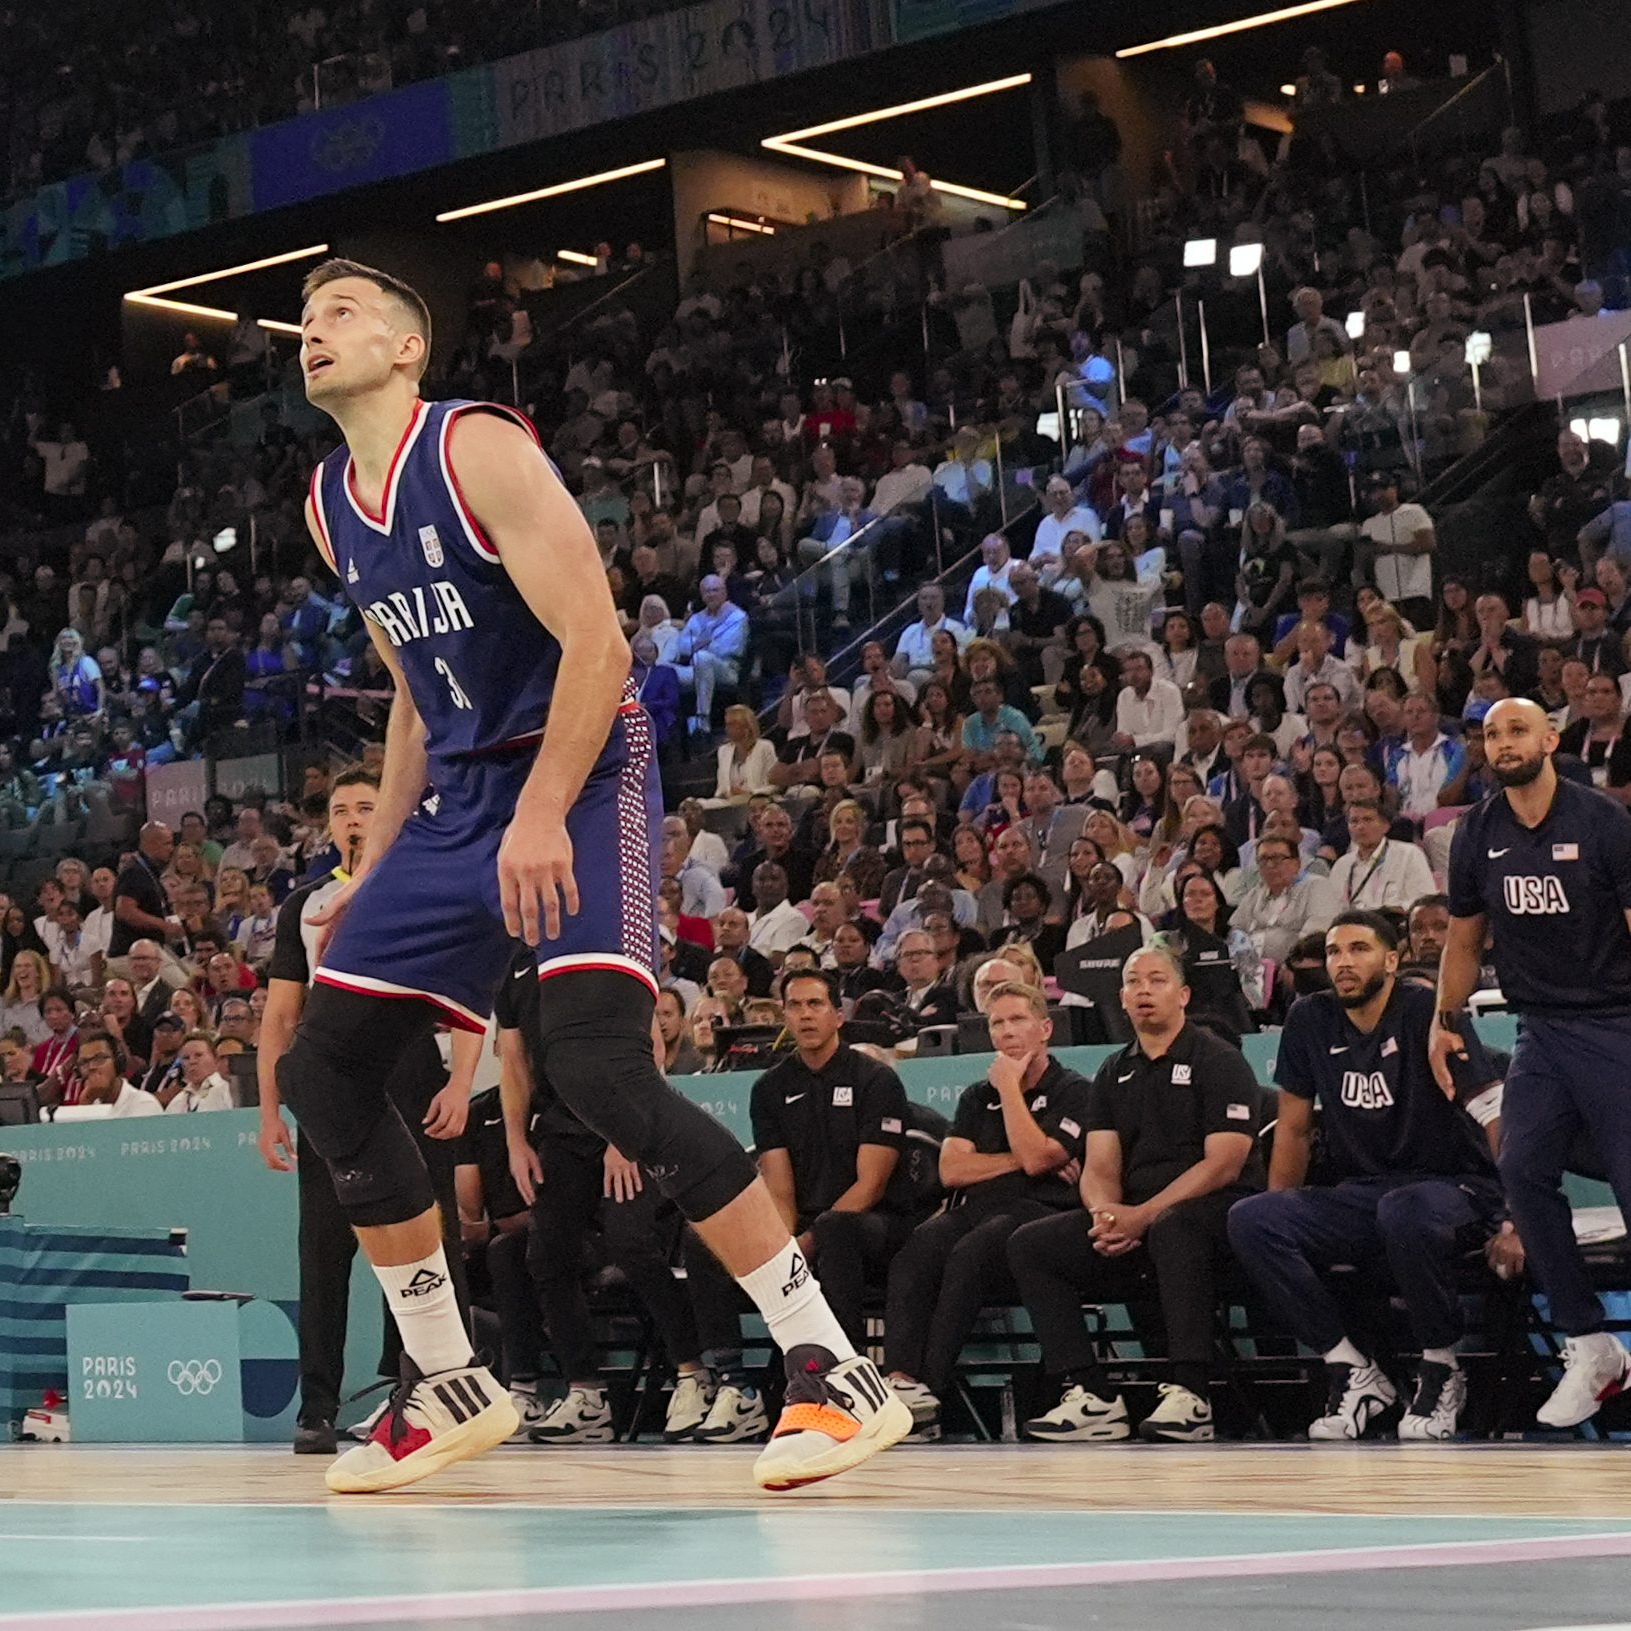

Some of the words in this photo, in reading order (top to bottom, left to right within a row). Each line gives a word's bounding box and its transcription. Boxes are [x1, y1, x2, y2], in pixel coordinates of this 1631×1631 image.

[435, 657, 473, 710] 3
[1503, 875, 1570, 915] USA
[1340, 1070, 1395, 1110] USA
[781, 1269, 810, 1298] PEA
[83, 1356, 136, 1376] PARIS
[84, 1379, 137, 1399] 2024
